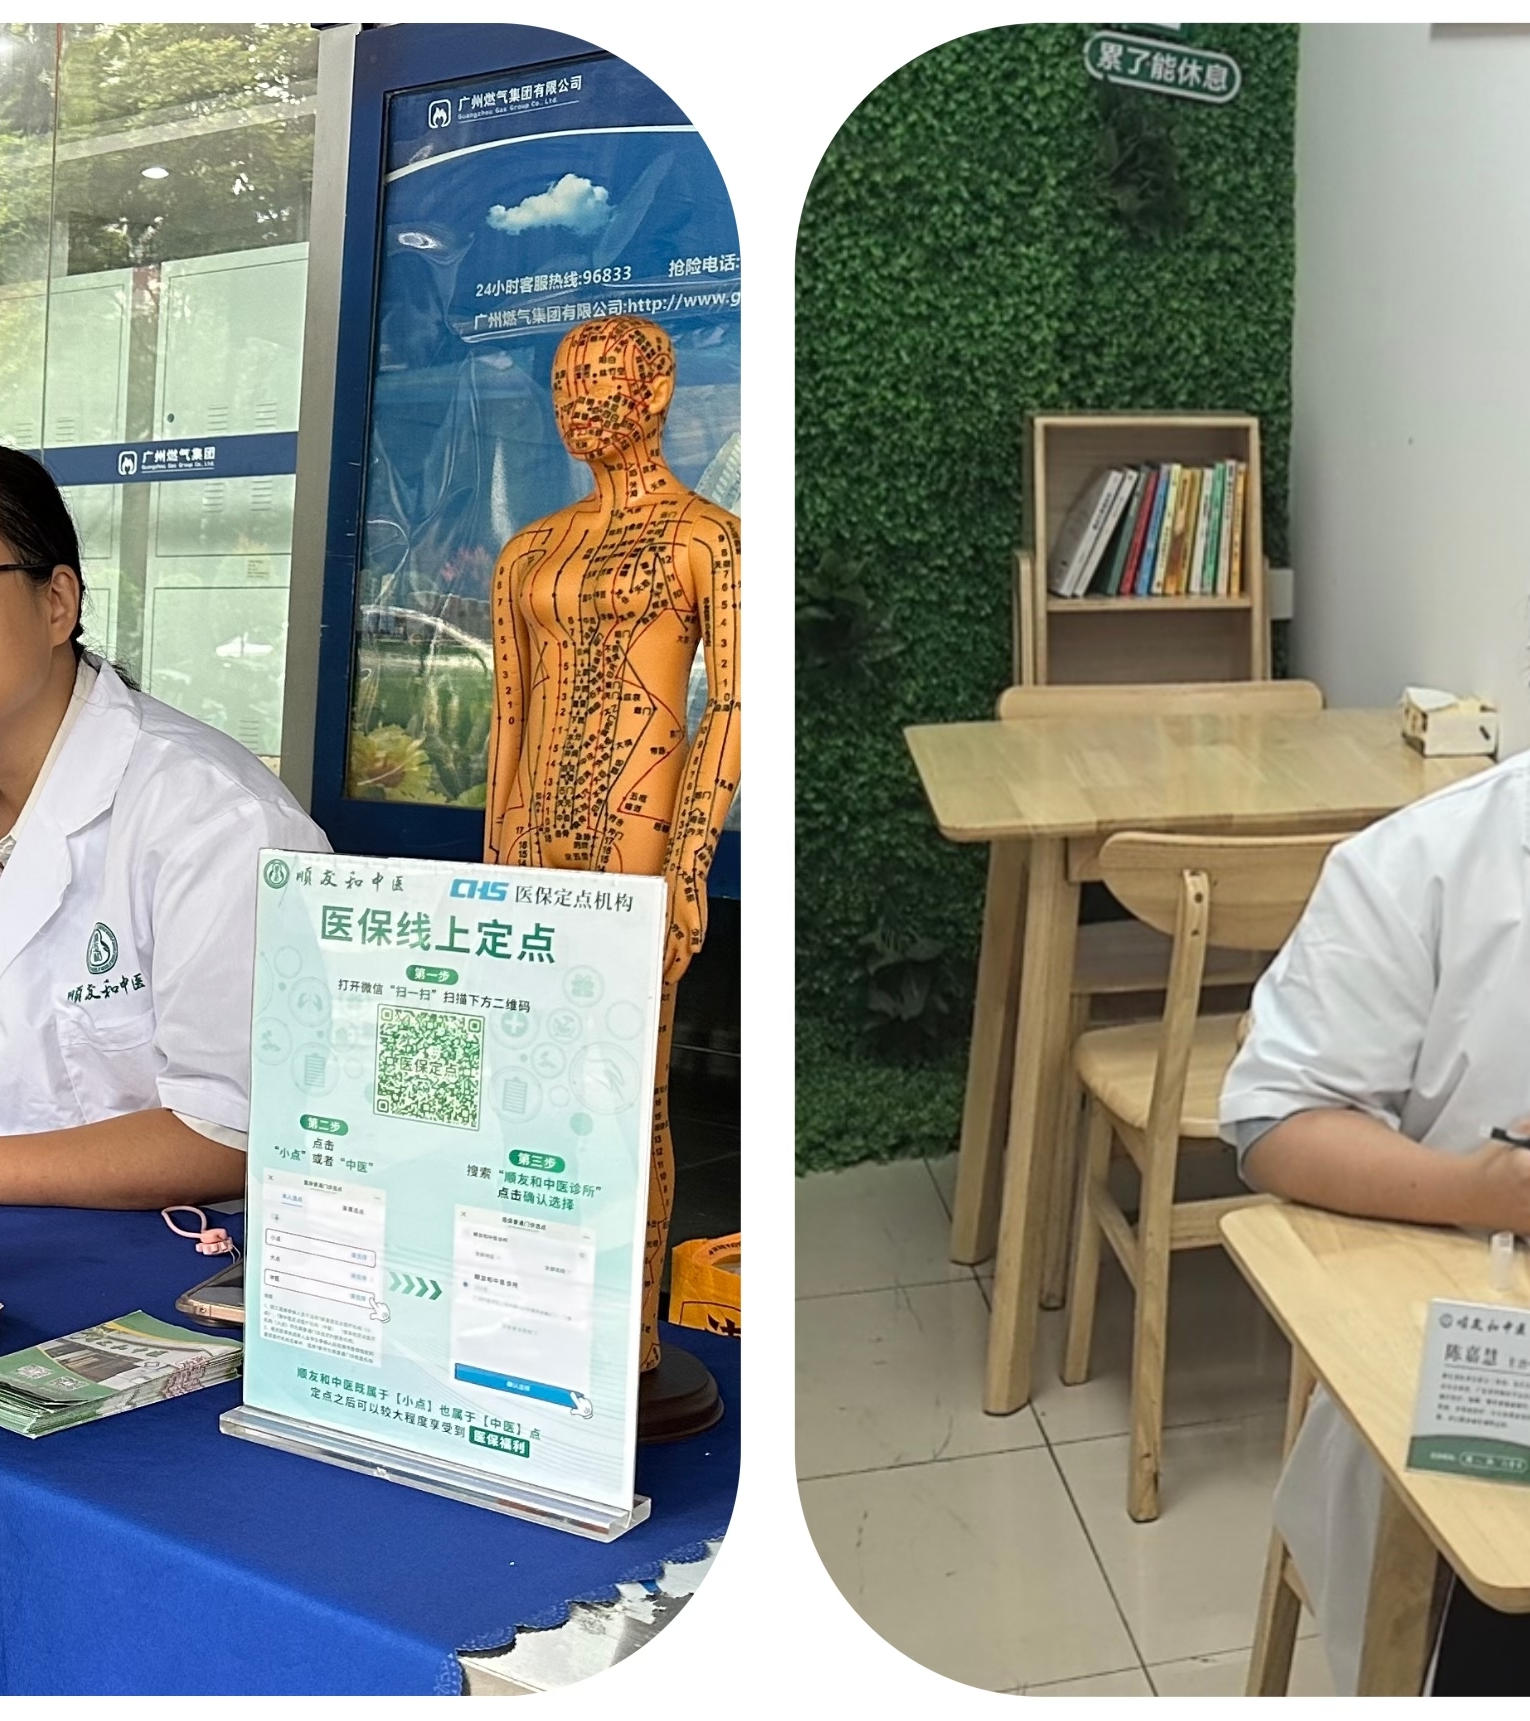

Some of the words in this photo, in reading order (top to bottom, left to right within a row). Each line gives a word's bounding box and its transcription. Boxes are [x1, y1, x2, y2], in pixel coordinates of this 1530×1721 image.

[1095, 40, 1229, 94] 累了能休息
[458, 75, 582, 112] 广州燃气集团有限公司
[476, 266, 632, 297] 24小时客服热线:96833
[141, 447, 216, 464] 广州燃气集团
[450, 877, 511, 903] CHS
[514, 884, 634, 913] 医保定点机构
[320, 904, 557, 964] 医保线上定点
[413, 967, 450, 984] 第一步
[307, 1117, 342, 1133] 第二步
[312, 1138, 335, 1152] 点击
[517, 1151, 557, 1170] 第三步
[497, 1187, 575, 1211] 点击确认选择
[310, 1386, 466, 1439] 定点之后可以较大程度享受到
[473, 1429, 526, 1455] 医保福利
